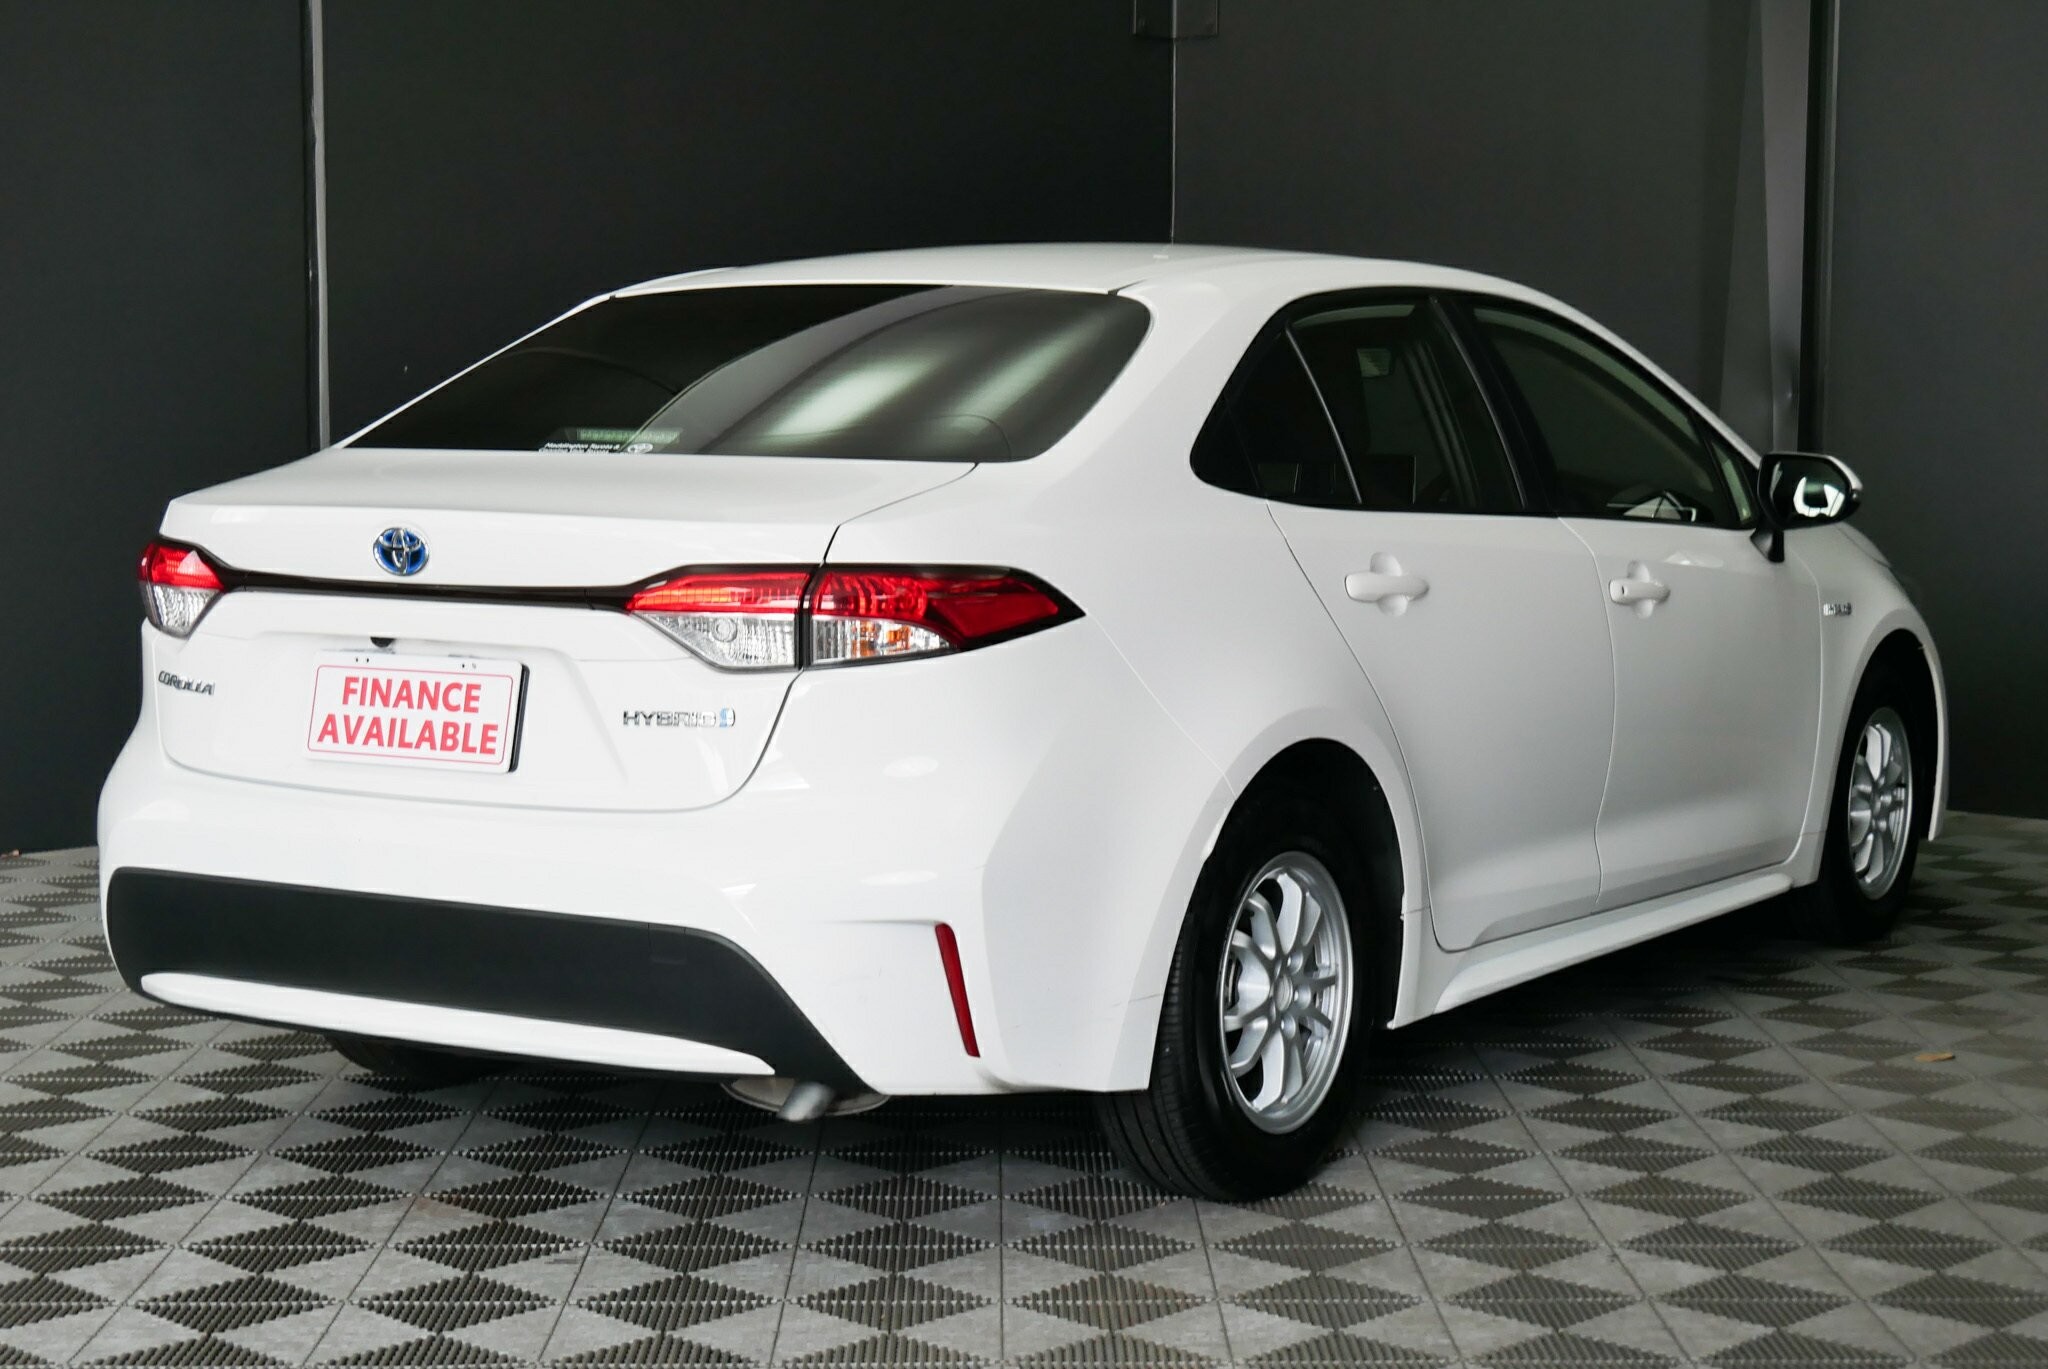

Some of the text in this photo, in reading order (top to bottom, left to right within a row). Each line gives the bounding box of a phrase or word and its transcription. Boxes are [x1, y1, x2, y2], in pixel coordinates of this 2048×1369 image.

[158, 670, 215, 696] COROLLA
[342, 676, 481, 713] FINANCE
[317, 714, 498, 755] AVAILABLE
[623, 710, 717, 728] HYBRID
